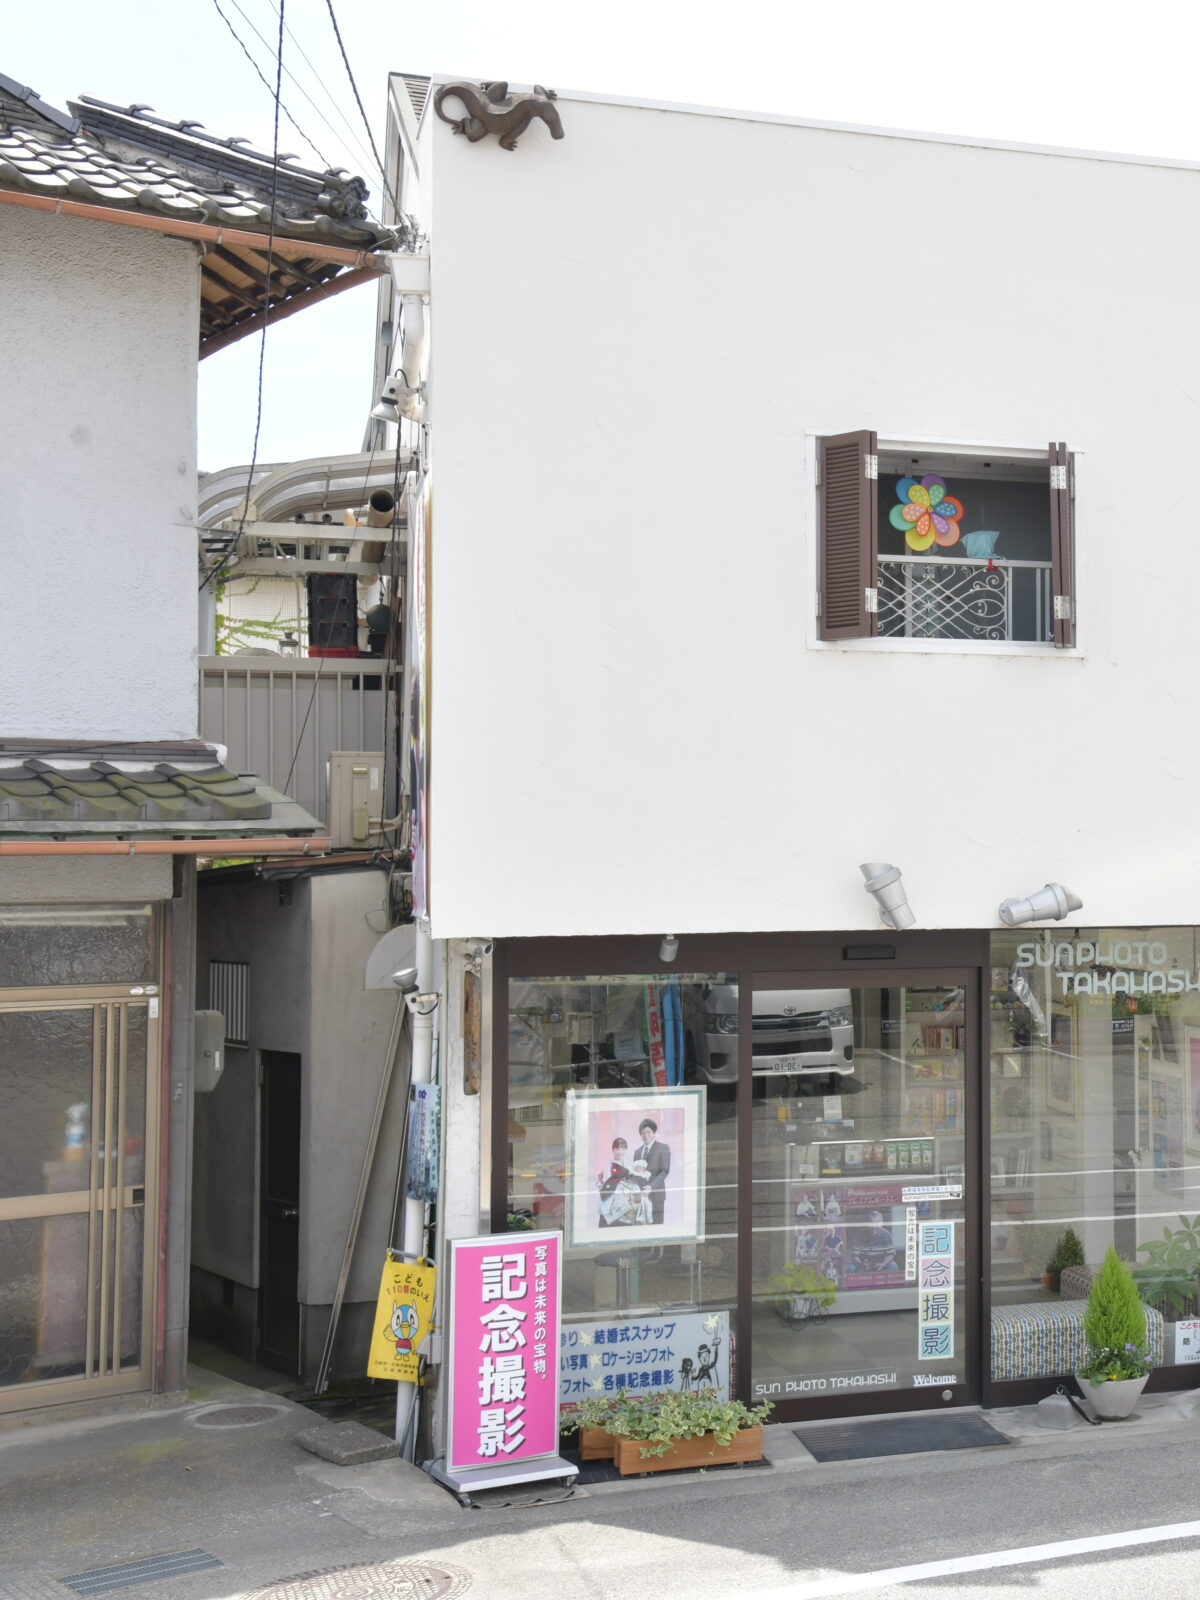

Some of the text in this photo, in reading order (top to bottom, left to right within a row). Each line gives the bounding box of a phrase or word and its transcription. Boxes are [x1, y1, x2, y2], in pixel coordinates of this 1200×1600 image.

[394, 1273, 423, 1287] こども
[922, 1227, 951, 1355] 記念撮影
[386, 1285, 430, 1303] 110番のいえ
[533, 1245, 548, 1380] 写真は未来の宝物。
[594, 1322, 676, 1345] 結婚式スナップ
[476, 1252, 529, 1458] 記念撮影
[602, 1347, 675, 1367] ロケーションフォト
[603, 1369, 674, 1391] 各種記念撮影
[755, 1373, 897, 1395] SUN PHOTO TAKAHASHI
[913, 1374, 957, 1387] Welcome
